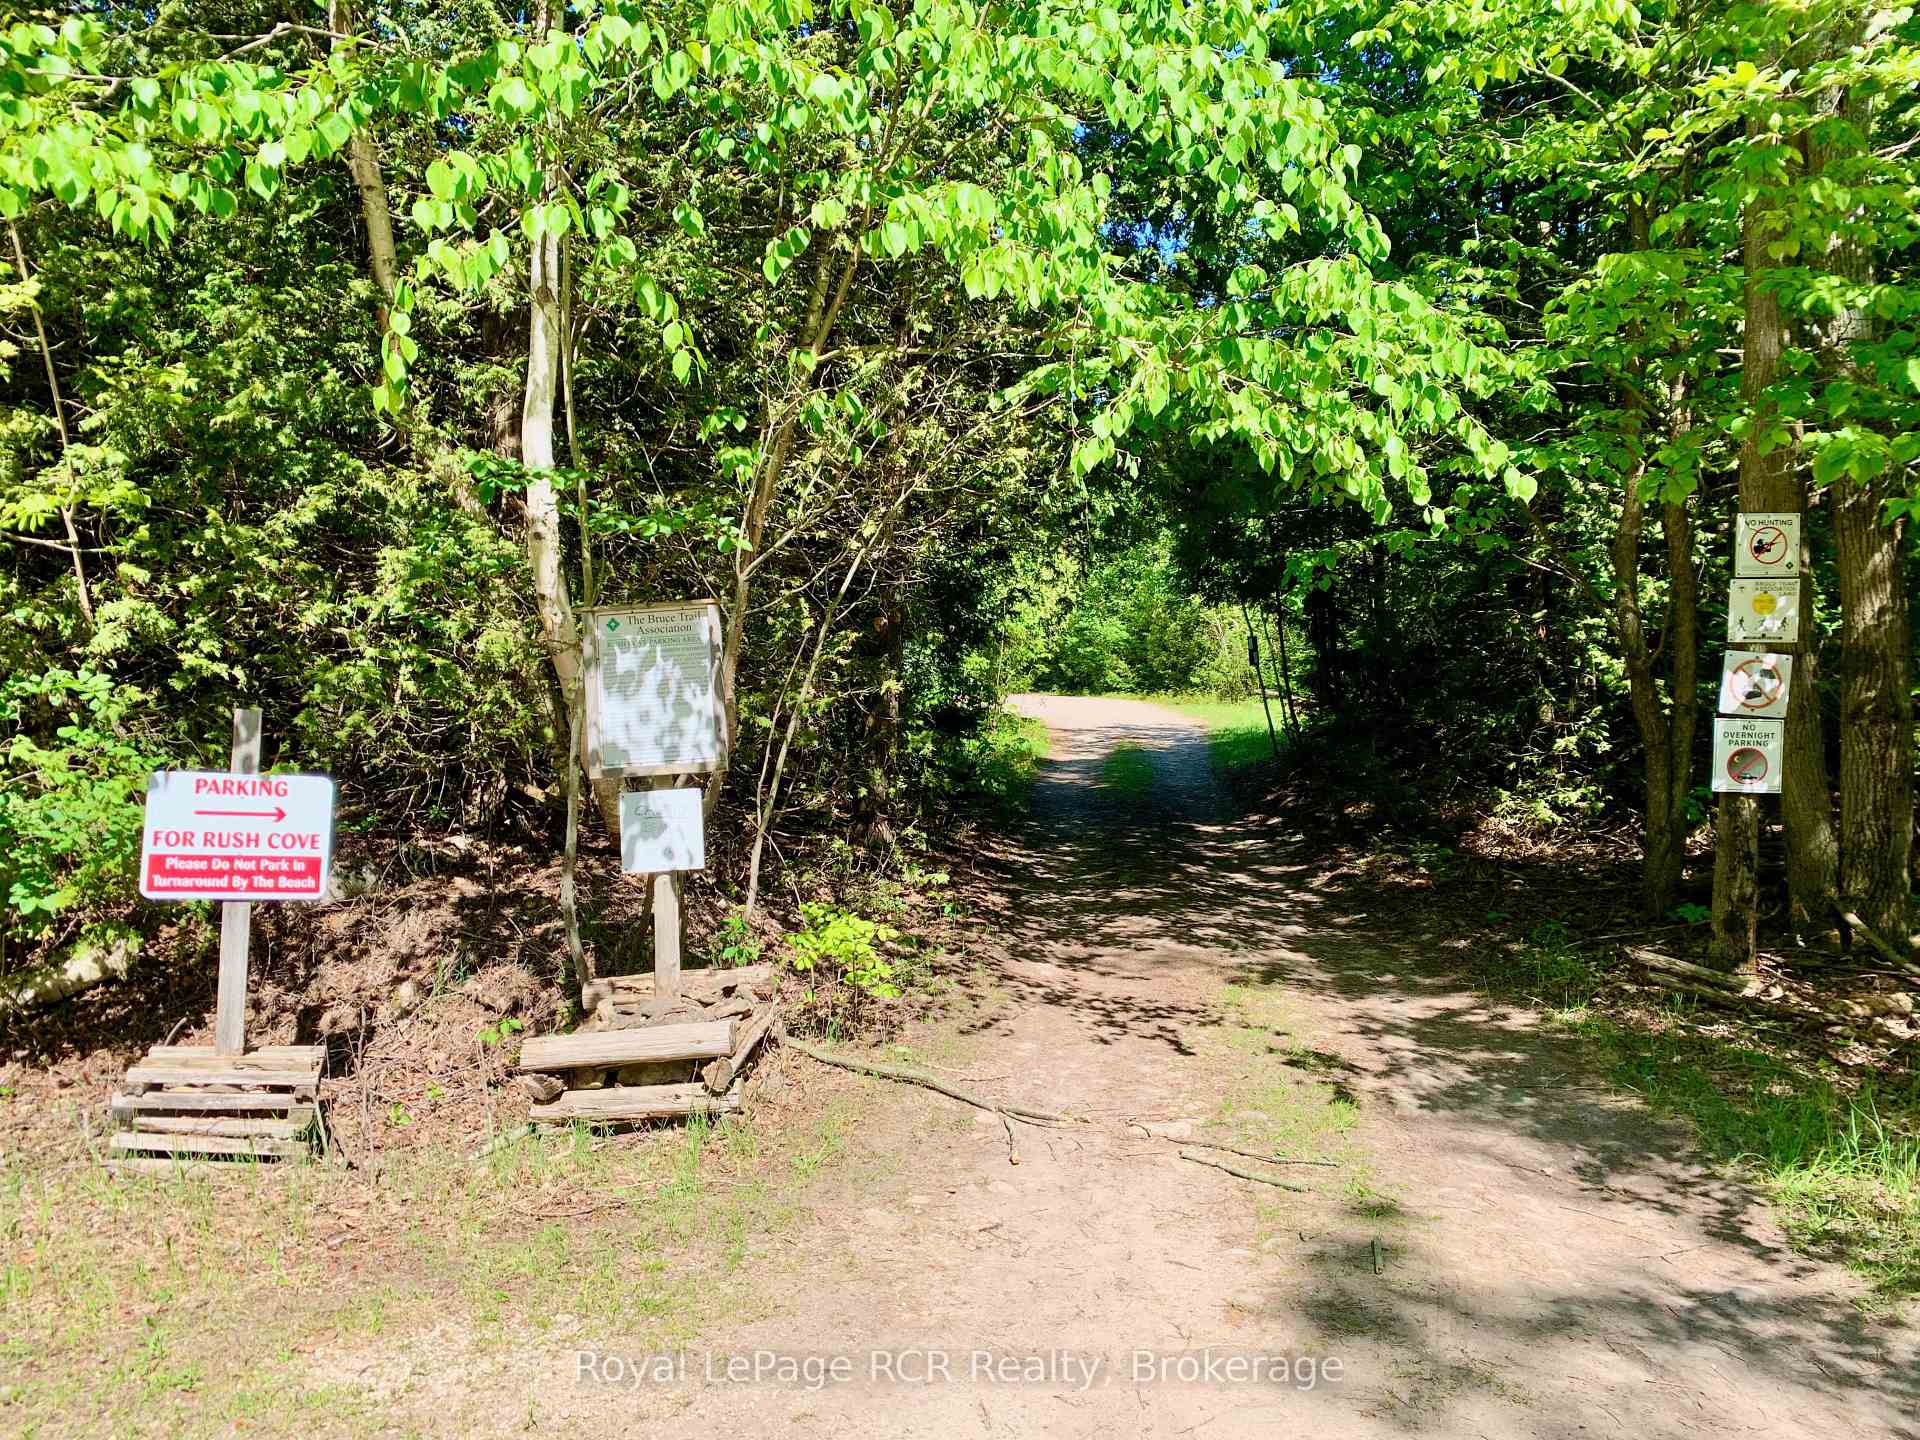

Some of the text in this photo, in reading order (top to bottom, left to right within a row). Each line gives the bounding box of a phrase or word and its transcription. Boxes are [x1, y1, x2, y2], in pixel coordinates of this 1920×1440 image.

[626, 611, 701, 625] The Bruce Trail
[638, 625, 692, 635] Association
[1723, 731, 1776, 739] OVERNIGHT
[1728, 739, 1769, 747] PARKING
[194, 778, 289, 797] PARKING
[152, 830, 321, 850] FOR RUSH COVE
[165, 857, 305, 871] Please Do Not Park In
[152, 874, 316, 890] Turnaround By The Beach
